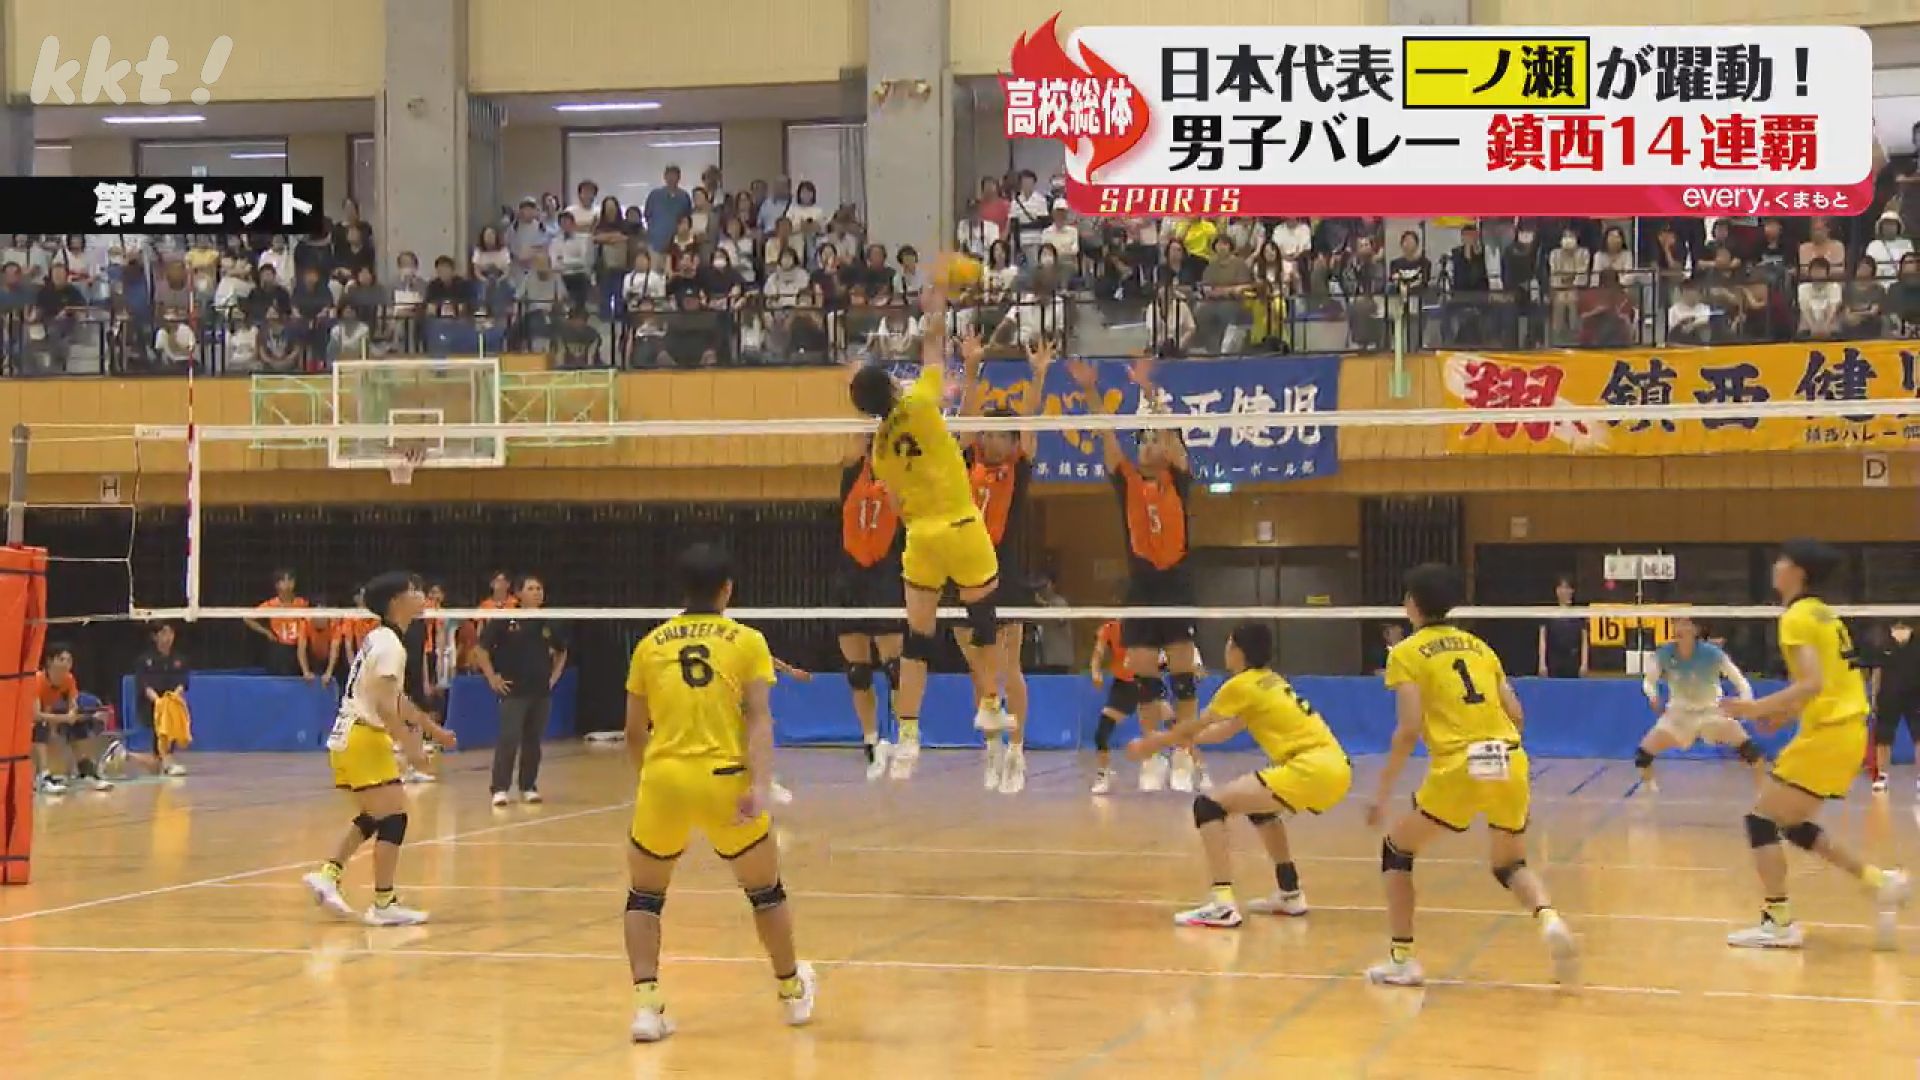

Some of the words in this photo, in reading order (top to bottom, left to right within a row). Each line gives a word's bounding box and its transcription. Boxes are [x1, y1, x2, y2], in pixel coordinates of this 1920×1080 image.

[1866, 458, 1887, 479] D
[103, 478, 118, 497] H
[679, 644, 715, 688] 6
[1452, 658, 1486, 704] 1
